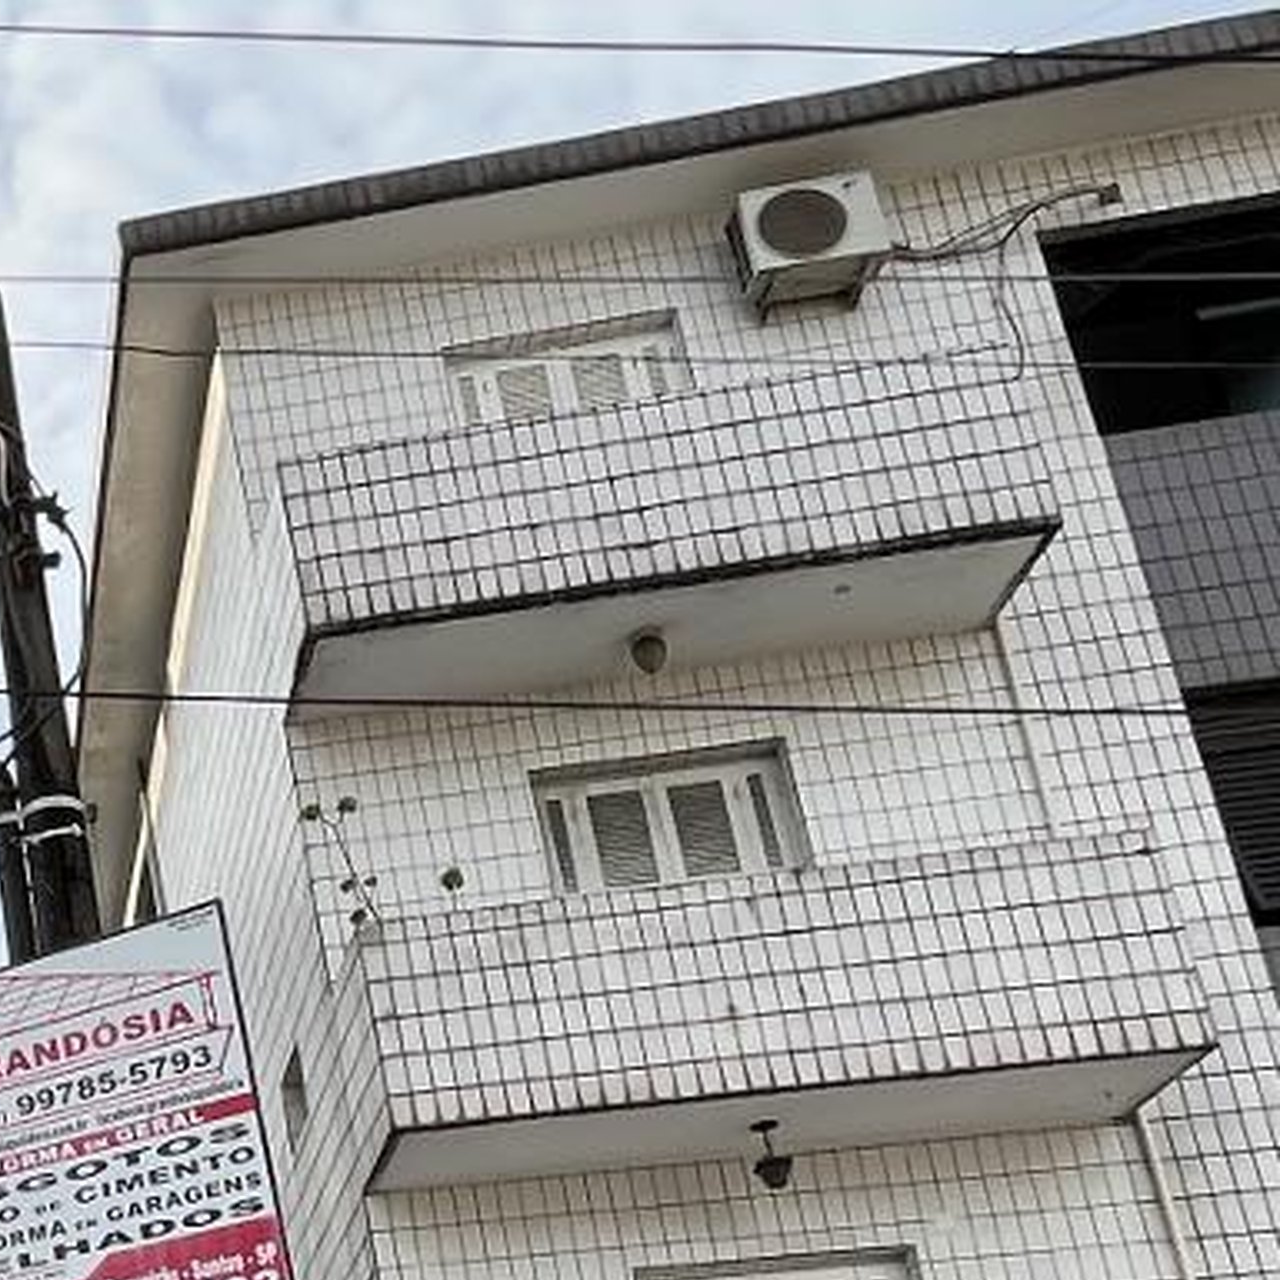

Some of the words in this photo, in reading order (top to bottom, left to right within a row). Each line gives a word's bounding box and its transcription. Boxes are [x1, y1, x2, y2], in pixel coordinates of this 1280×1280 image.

[15, 1045, 212, 1117] 99785-5793
[115, 1110, 205, 1142] GERAL
[73, 1146, 255, 1204] CIMENTO
[106, 1172, 262, 1221] GARAGENS
